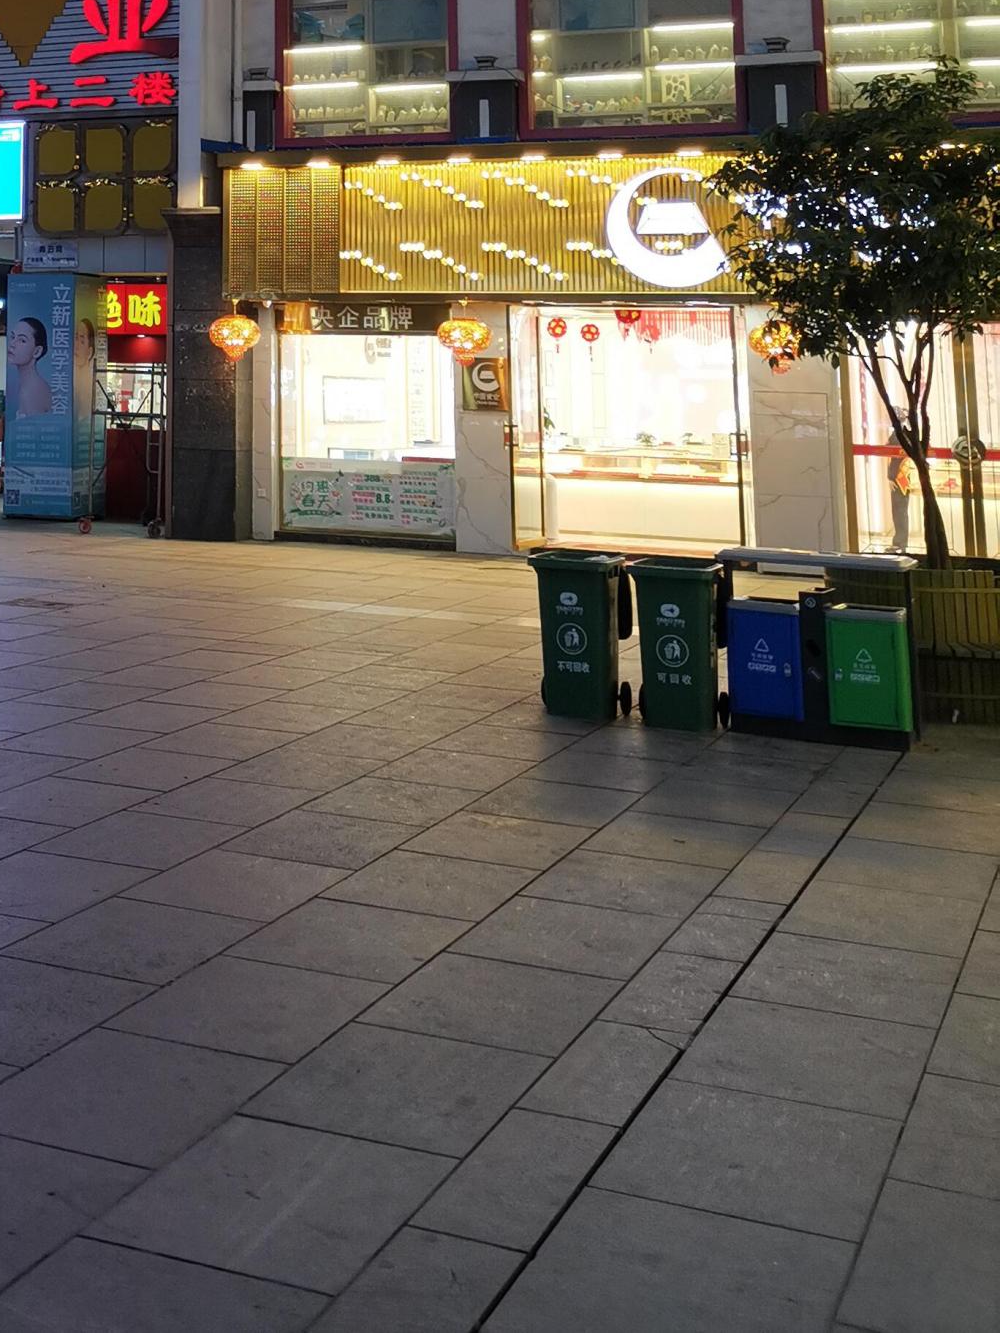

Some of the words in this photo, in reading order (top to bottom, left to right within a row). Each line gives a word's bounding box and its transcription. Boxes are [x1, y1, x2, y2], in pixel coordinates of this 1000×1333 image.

[312, 305, 414, 330] 央企品牌
[51, 283, 71, 416] 立新医学美容
[656, 672, 693, 686] 可回收
